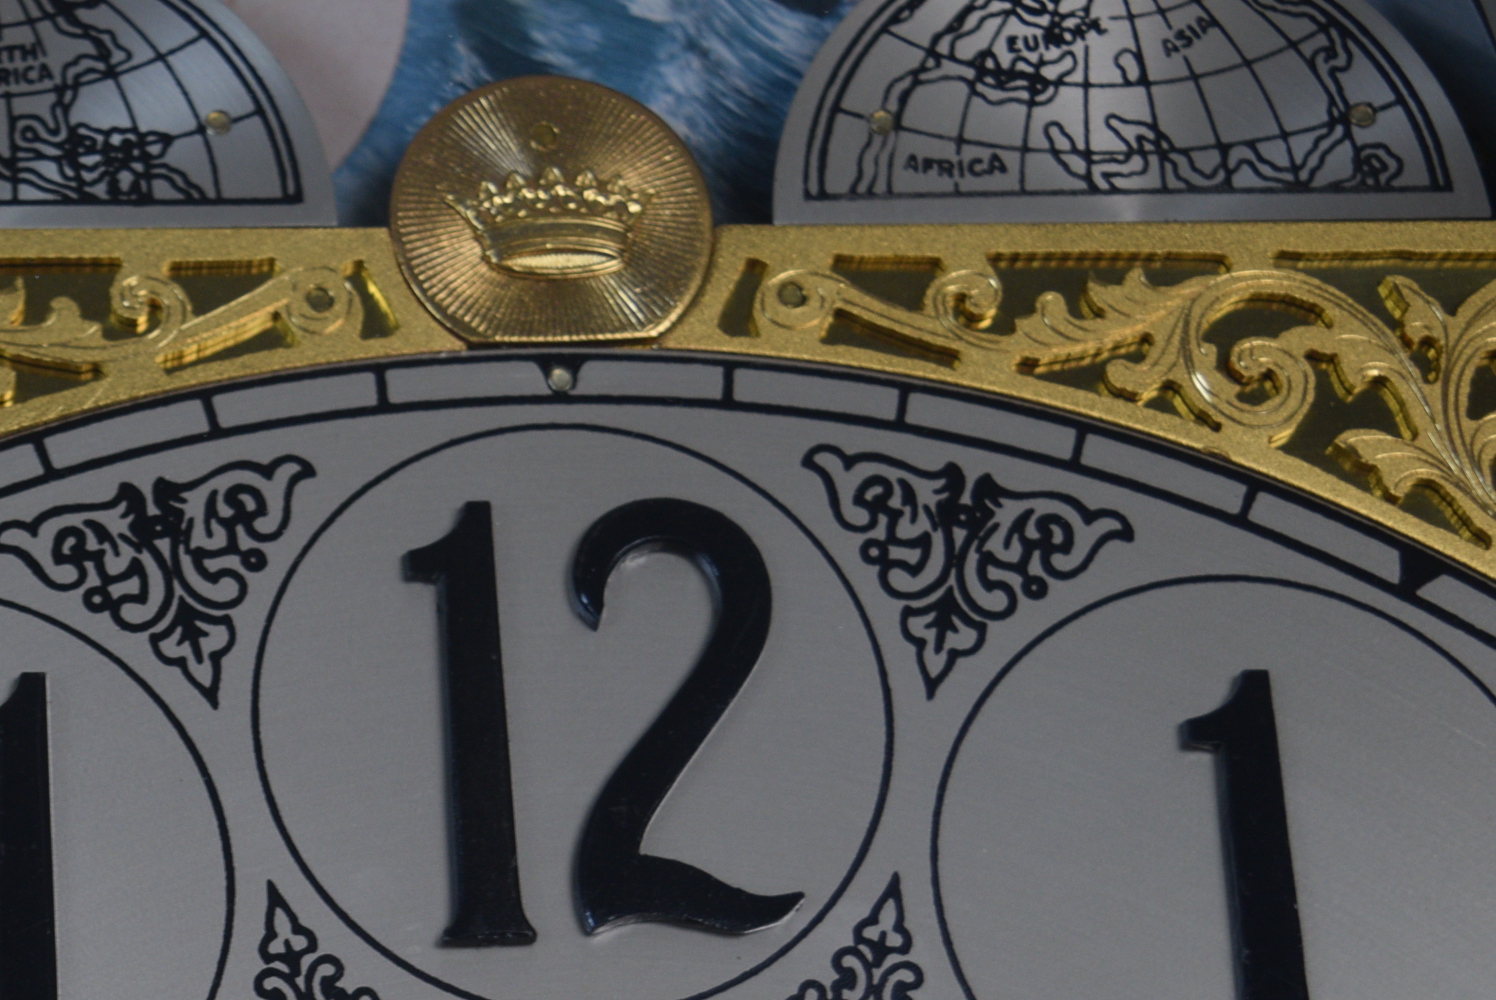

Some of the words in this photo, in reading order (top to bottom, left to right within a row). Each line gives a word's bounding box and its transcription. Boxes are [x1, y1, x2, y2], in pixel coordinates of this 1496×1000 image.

[1006, 16, 1108, 53] EUROPE
[1161, 15, 1217, 57] ASIA
[903, 152, 1008, 179] AFRICA
[398, 497, 806, 948] 12
